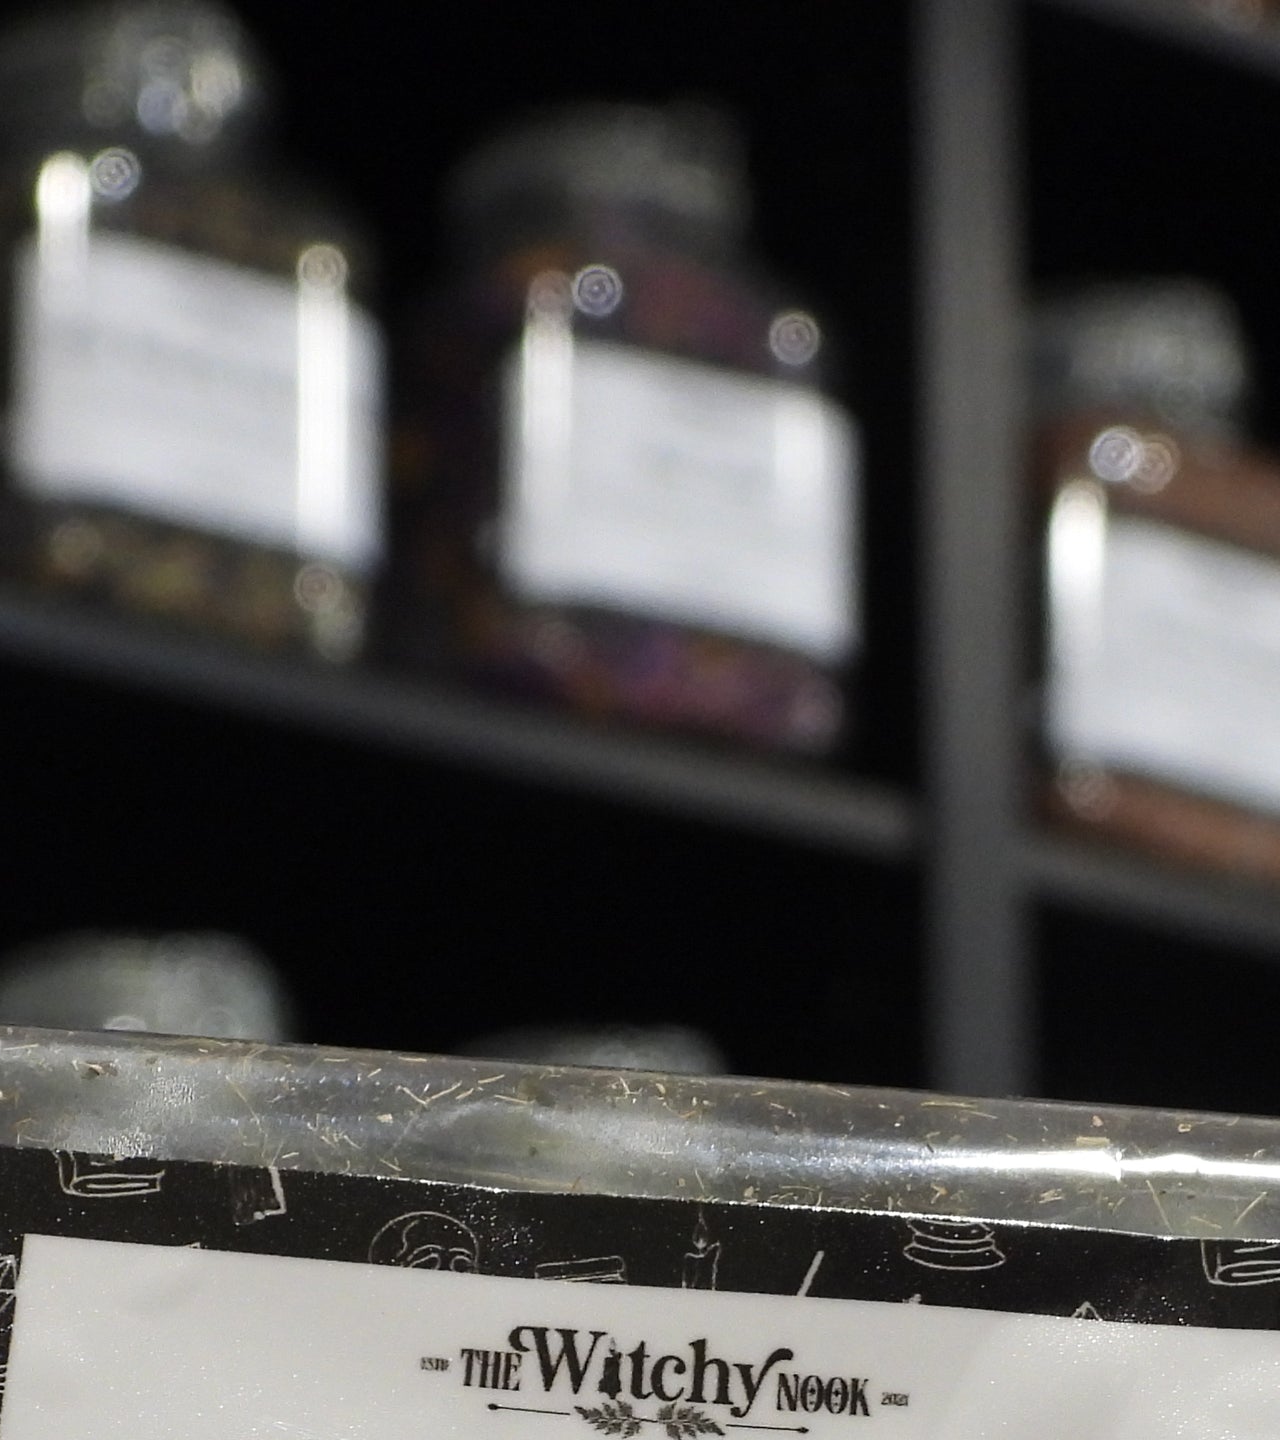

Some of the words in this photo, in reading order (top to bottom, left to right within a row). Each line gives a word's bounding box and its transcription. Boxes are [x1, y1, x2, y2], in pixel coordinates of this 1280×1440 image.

[460, 1348, 521, 1392] THE
[507, 1325, 795, 1419] Witchy
[776, 1372, 871, 1417] NOOK
